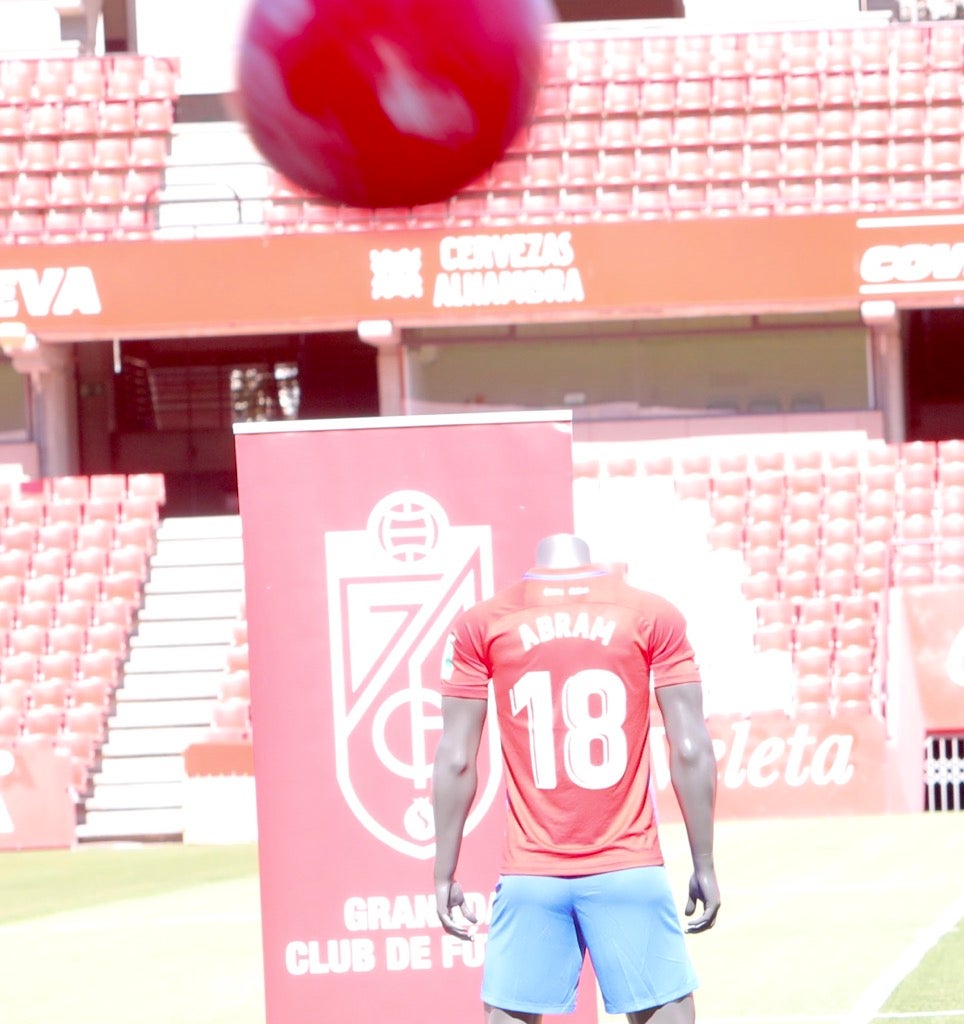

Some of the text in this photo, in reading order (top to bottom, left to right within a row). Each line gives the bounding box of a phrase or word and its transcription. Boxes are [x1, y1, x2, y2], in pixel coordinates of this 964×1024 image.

[439, 231, 575, 271] CERVEZAS
[518, 612, 616, 652] ABRAM
[510, 668, 628, 790] 18
[285, 938, 376, 976] CLUB
[385, 935, 432, 971] DE
